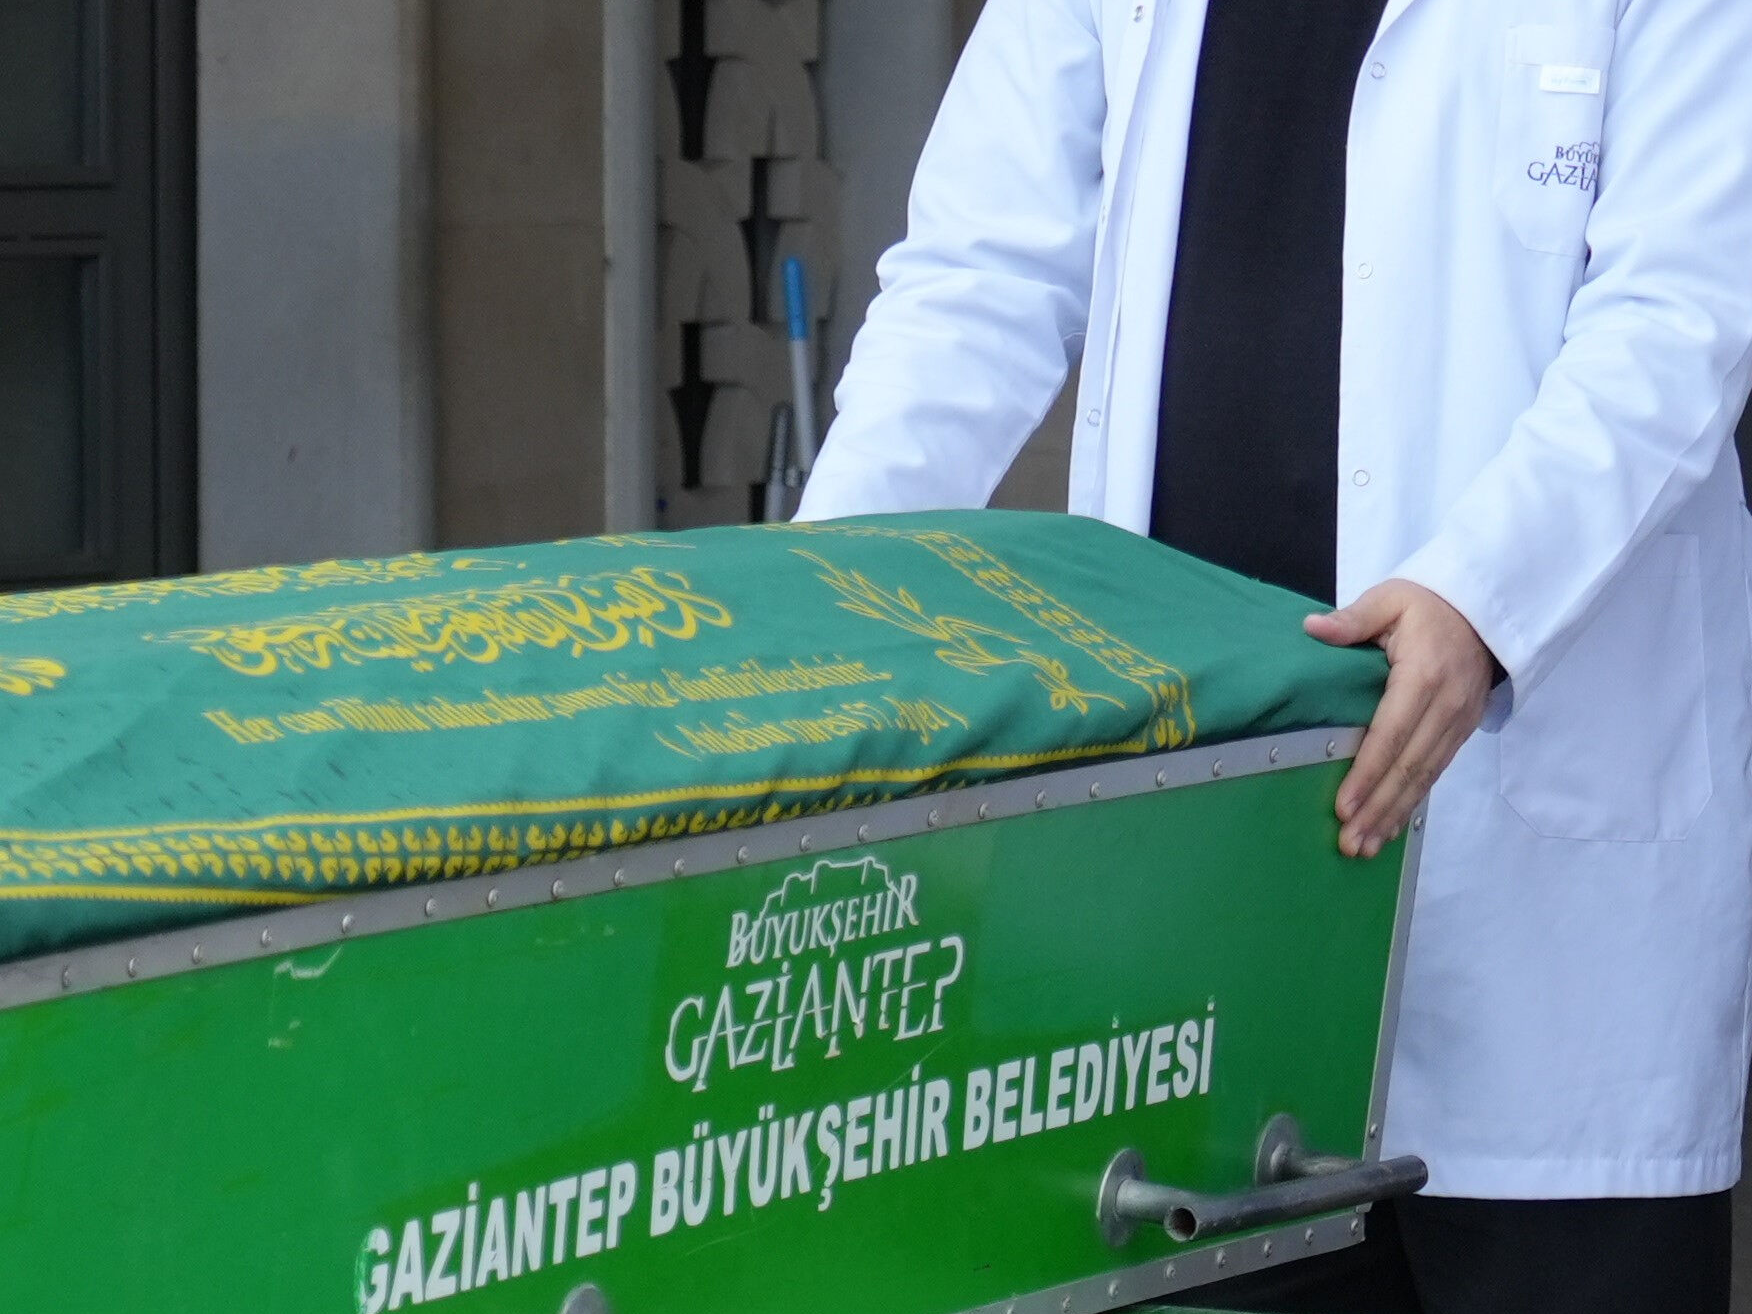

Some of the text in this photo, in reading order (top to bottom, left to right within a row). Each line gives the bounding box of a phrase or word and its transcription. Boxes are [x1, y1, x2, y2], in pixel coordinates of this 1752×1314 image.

[650, 1065, 952, 1212] BÜYÜKŞEHİR
[962, 994, 1221, 1152] BELEDİYESİ
[664, 935, 965, 1094] GAZİANTEP
